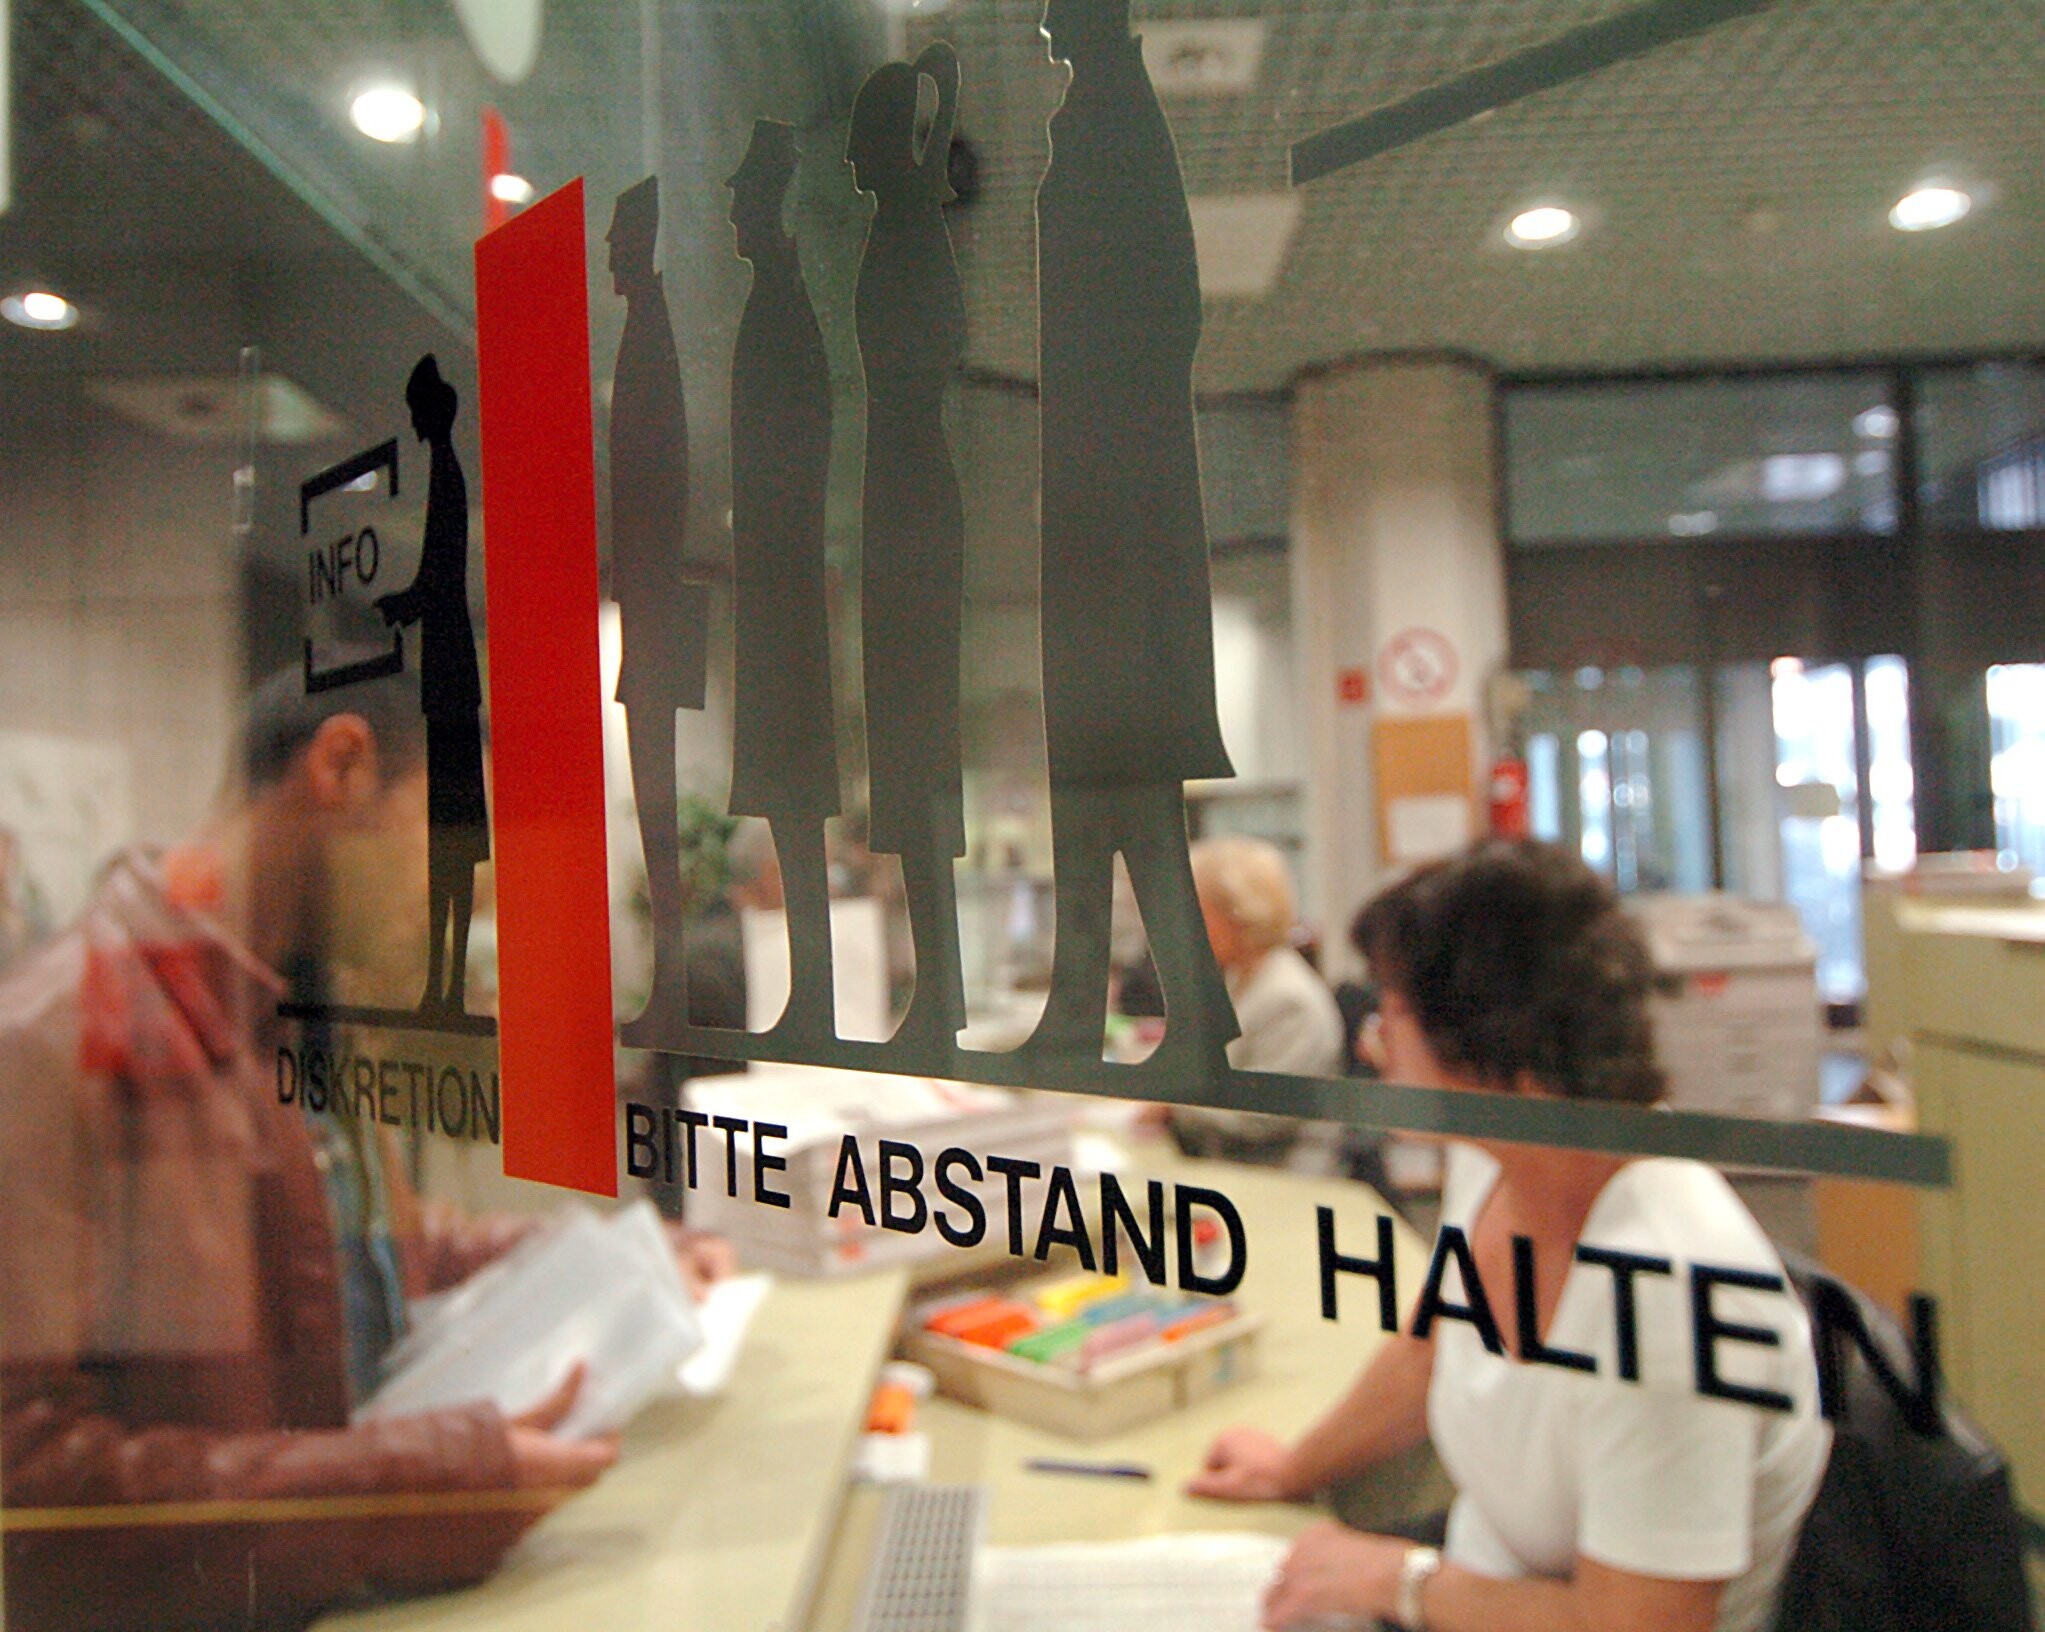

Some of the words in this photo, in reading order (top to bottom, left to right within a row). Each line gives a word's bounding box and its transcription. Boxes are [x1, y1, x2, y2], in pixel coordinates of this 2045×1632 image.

[309, 526, 378, 604] INFO
[277, 1046, 500, 1145] DISKRETION
[626, 1102, 790, 1209] BITTE
[828, 1134, 1247, 1296] ABSTAND
[1316, 1206, 1946, 1438] HALTEN
